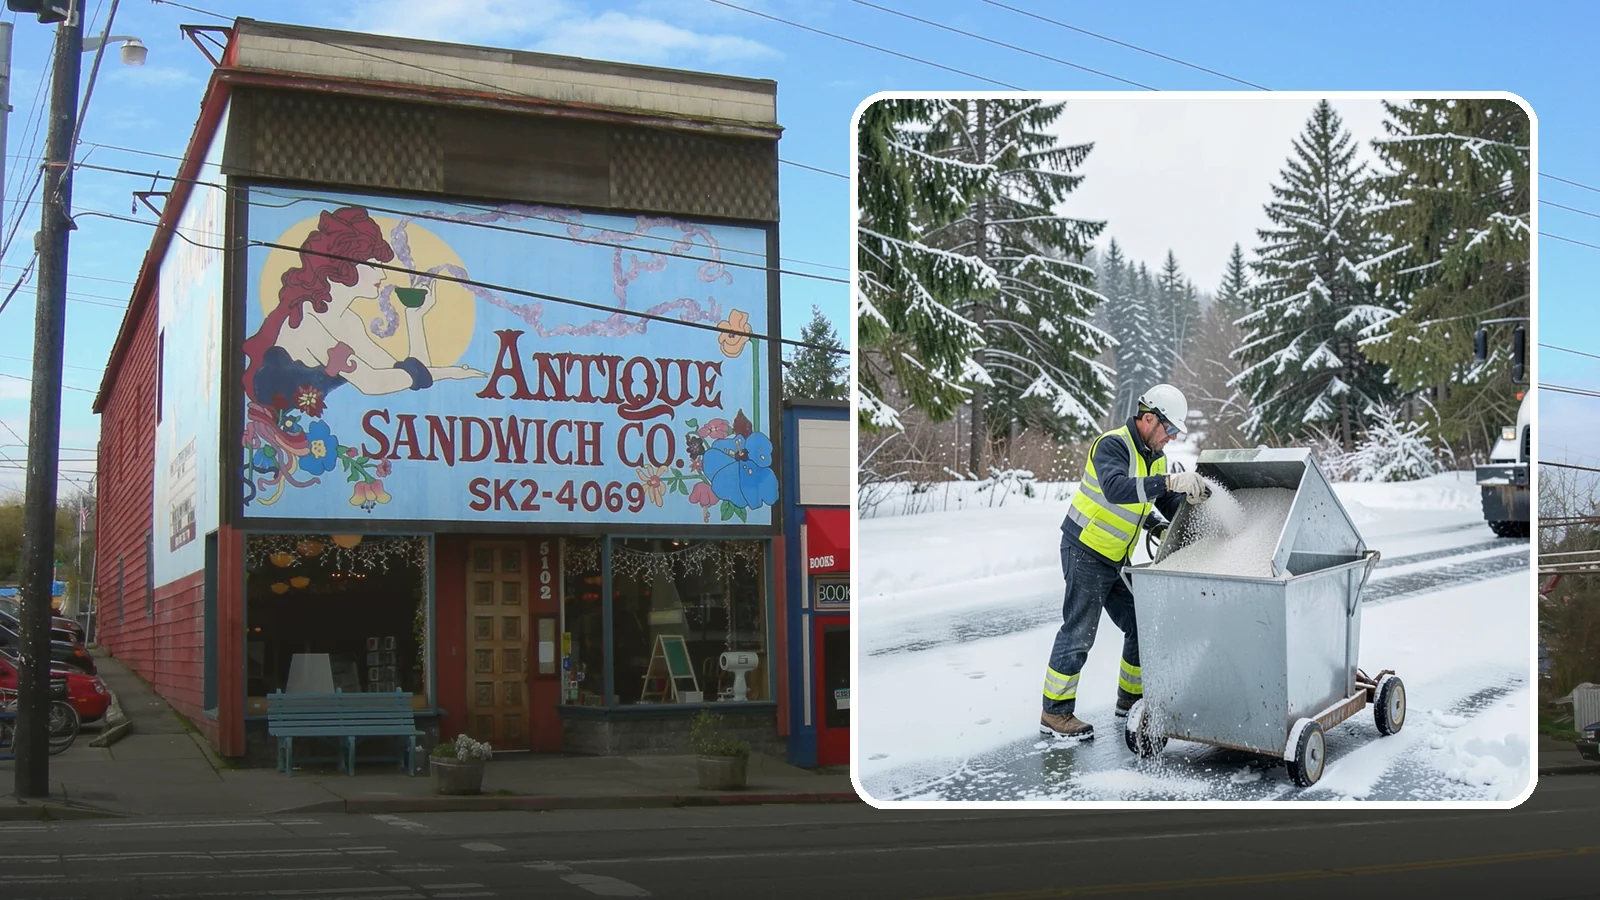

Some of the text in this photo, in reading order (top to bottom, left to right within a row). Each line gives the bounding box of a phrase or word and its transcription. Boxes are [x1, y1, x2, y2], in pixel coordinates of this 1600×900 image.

[475, 329, 724, 421] ANTIQUE
[361, 408, 685, 469] SANDWICH CO.
[468, 476, 647, 514] SK2-4069
[539, 541, 552, 600] 5102
[809, 555, 835, 569] BOOKS
